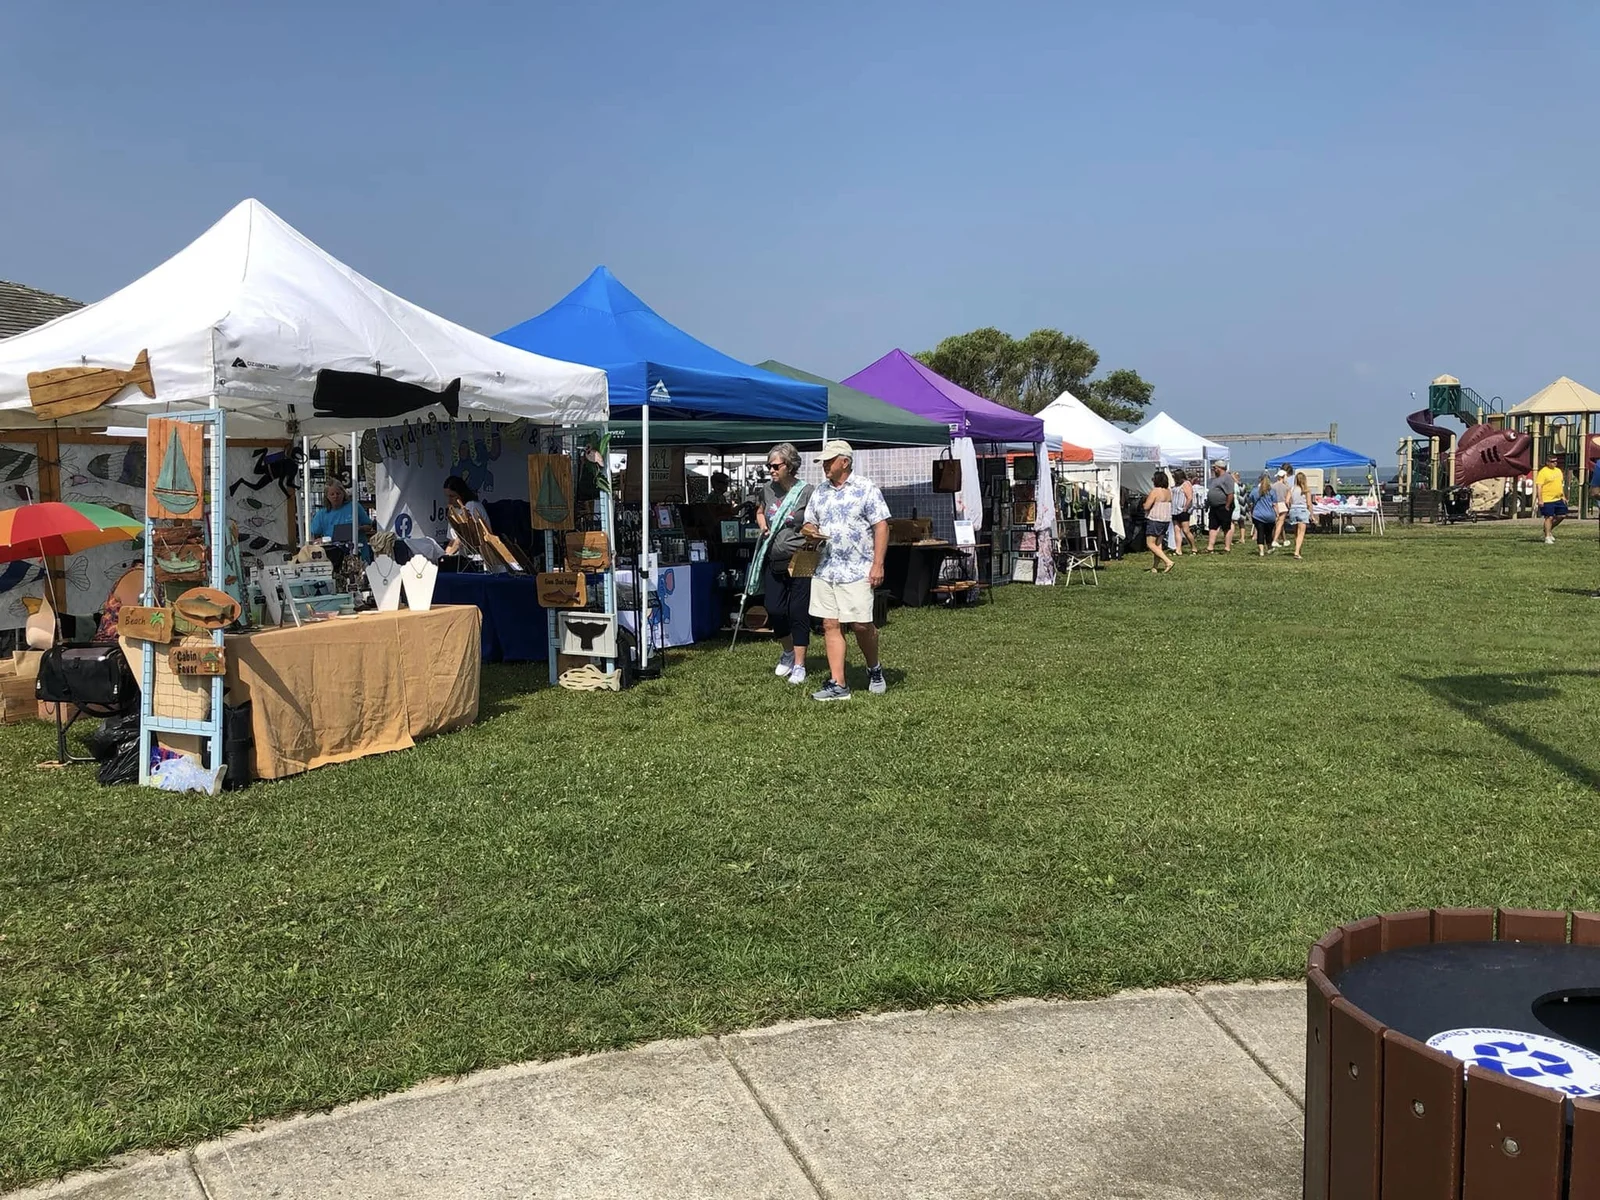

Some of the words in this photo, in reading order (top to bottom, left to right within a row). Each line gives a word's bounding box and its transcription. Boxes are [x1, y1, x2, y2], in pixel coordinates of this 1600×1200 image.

[125, 615, 146, 625] Beach
[177, 651, 197, 662] Cabin
[177, 664, 198, 674] Fever
[1430, 1030, 1470, 1047] Chance
[1471, 1029, 1536, 1040] Second
